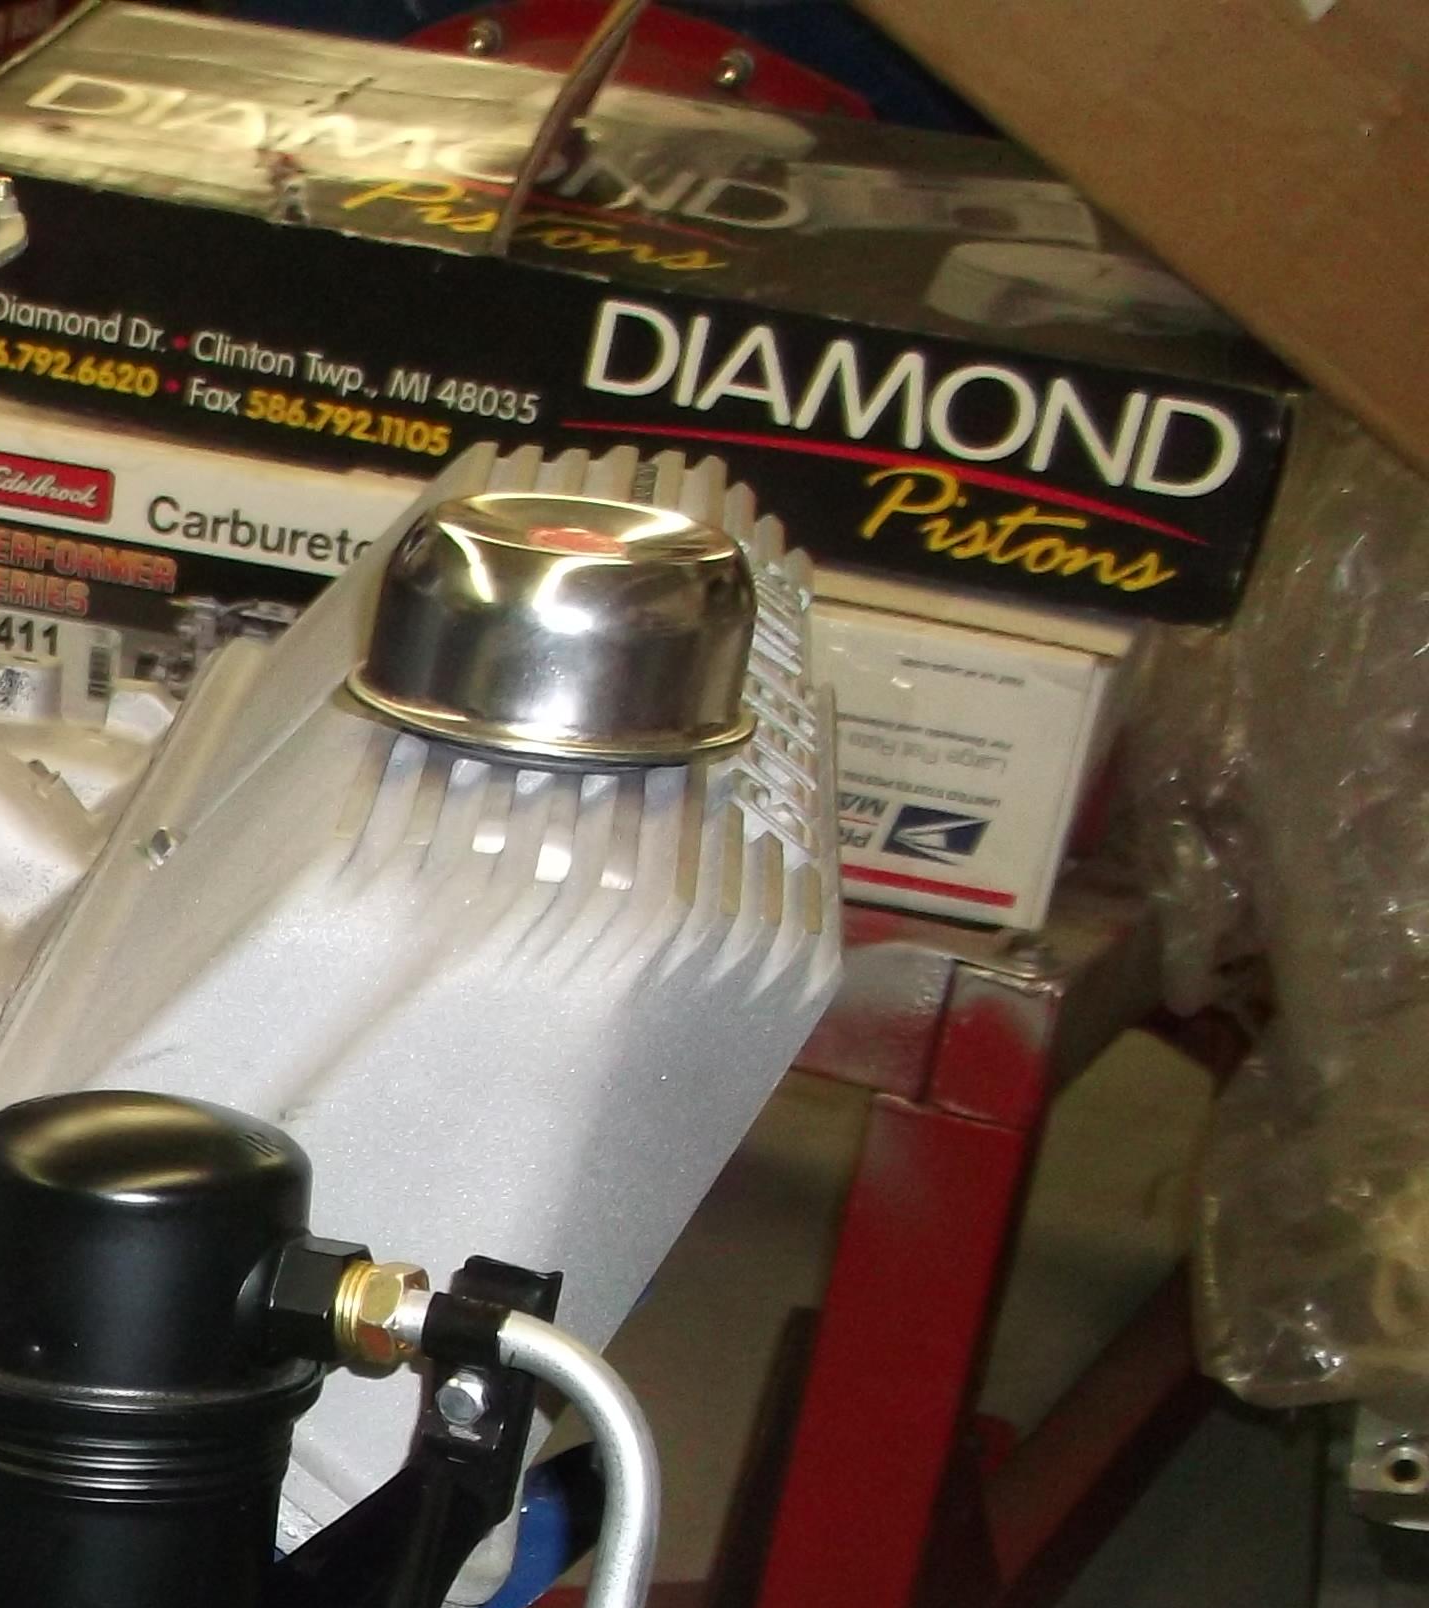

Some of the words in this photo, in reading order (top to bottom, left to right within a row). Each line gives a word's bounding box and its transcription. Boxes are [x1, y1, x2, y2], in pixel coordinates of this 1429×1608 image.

[128, 317, 167, 352] Dr.
[194, 330, 295, 378] Clinton
[305, 351, 379, 398] Twp.,
[390, 369, 432, 404] MI
[437, 378, 540, 424] 48035
[188, 376, 241, 416] Fax
[244, 389, 453, 457] 586.792.1105
[584, 299, 1241, 498] DIAMOND
[860, 466, 1178, 592] Pistons
